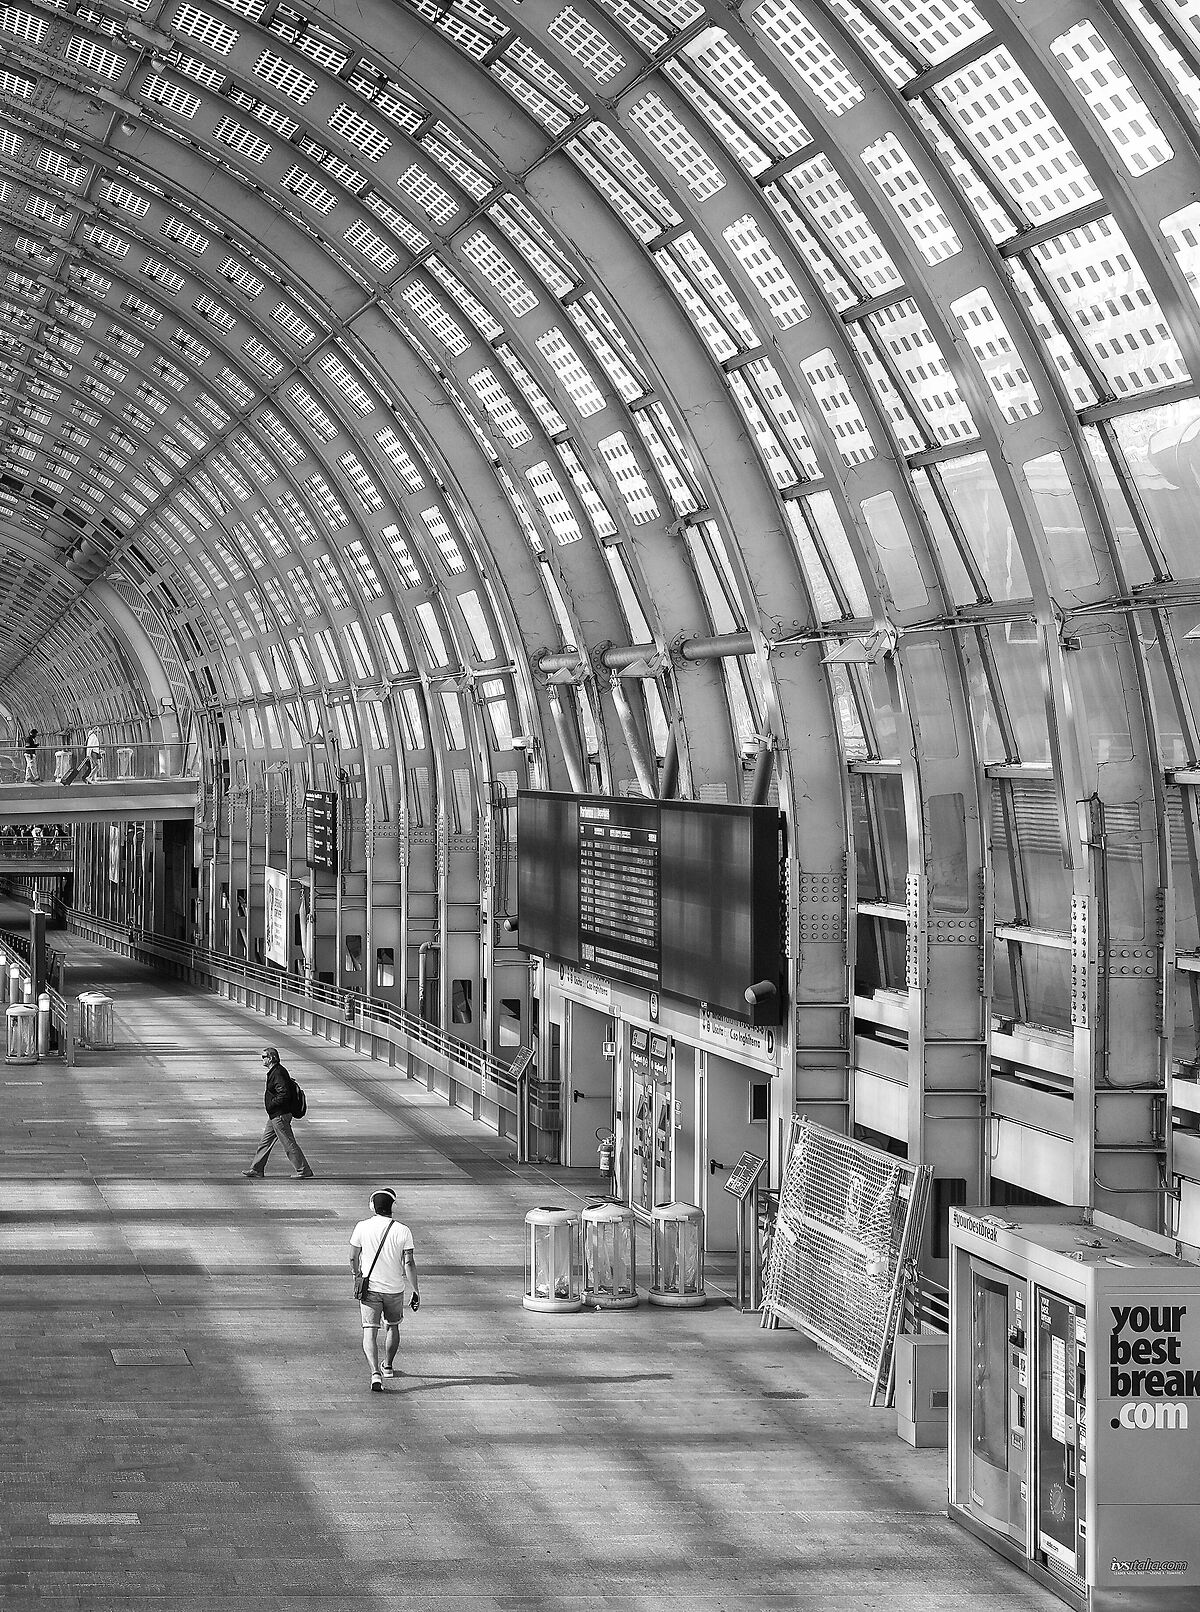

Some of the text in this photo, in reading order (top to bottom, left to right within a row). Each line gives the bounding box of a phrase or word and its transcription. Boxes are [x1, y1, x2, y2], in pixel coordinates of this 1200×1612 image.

[953, 1210, 998, 1243] #yourbestbreak
[1110, 1306, 1187, 1335] your
[1110, 1335, 1182, 1365] best
[1110, 1402, 1189, 1430] .com
